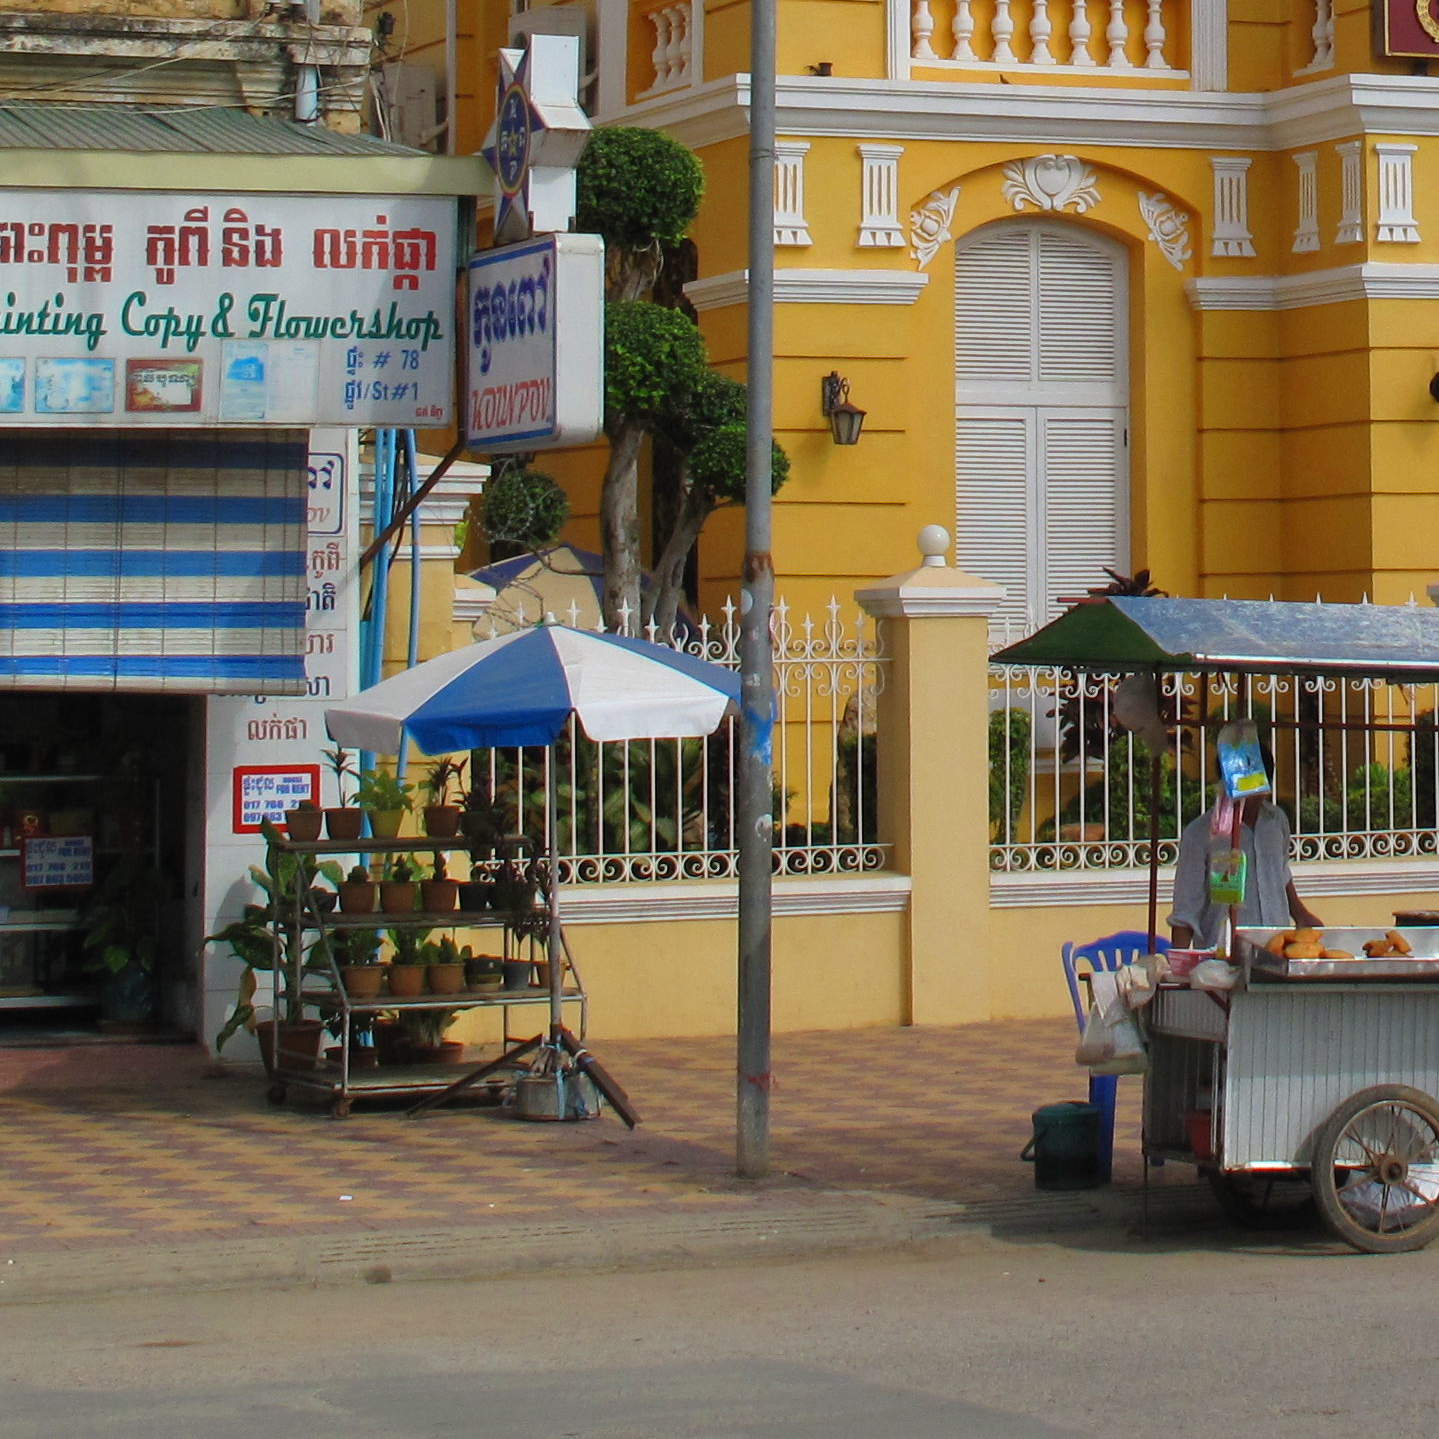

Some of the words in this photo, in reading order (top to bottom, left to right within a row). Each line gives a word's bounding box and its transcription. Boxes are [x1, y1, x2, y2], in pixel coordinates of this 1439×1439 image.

[0, 291, 108, 351] inting
[122, 291, 206, 352] Copy
[211, 292, 235, 338] &
[248, 292, 444, 352] Flowershop
[401, 349, 420, 370] 78
